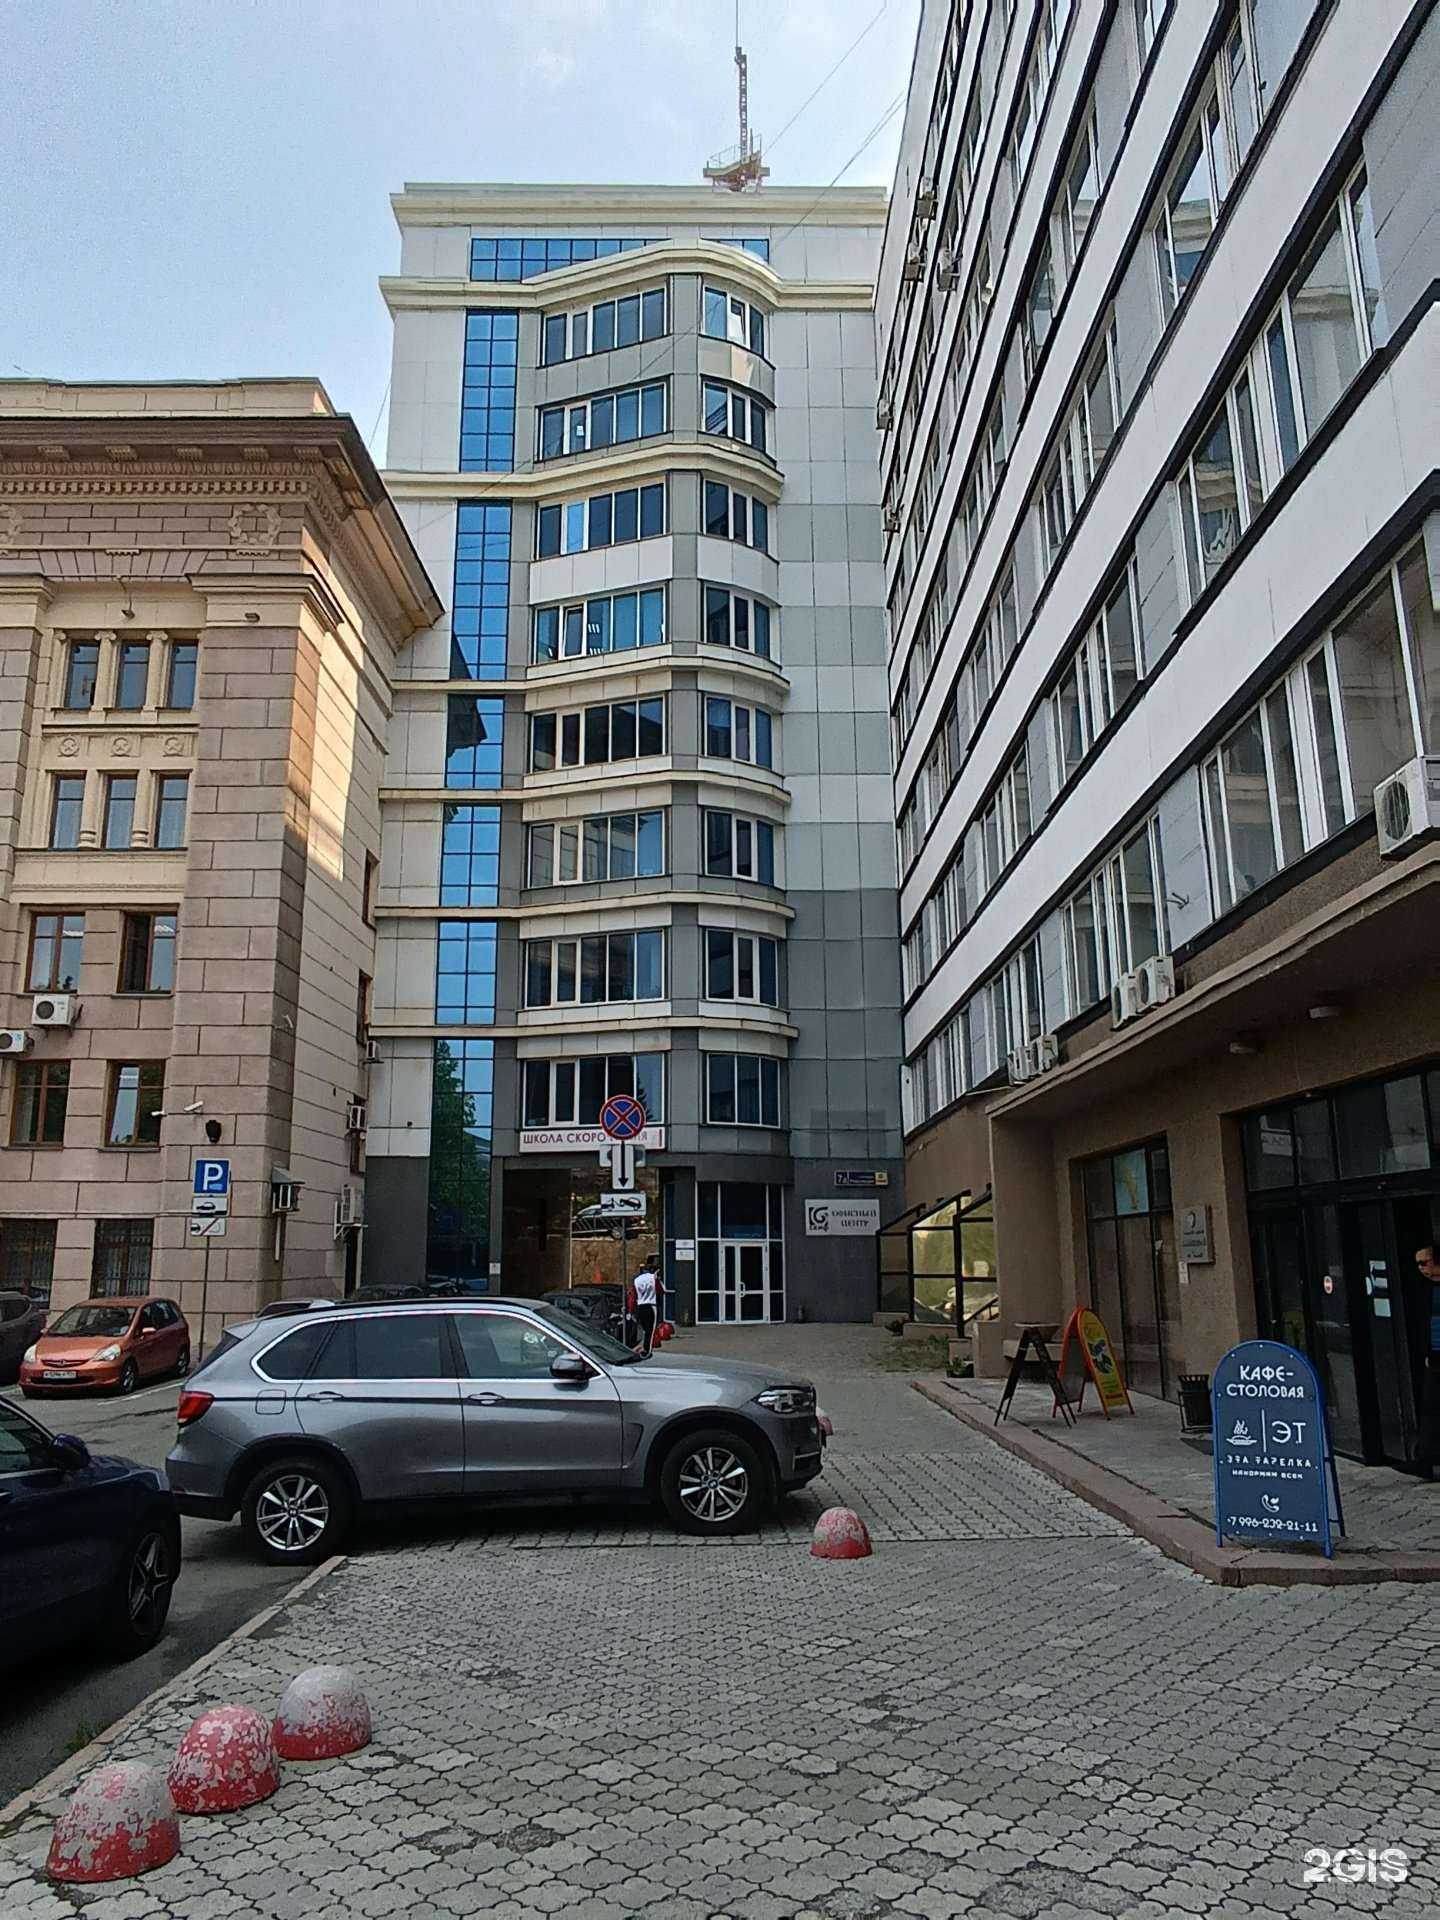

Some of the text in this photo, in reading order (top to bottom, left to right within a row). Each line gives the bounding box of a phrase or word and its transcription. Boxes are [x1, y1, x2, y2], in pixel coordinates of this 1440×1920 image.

[523, 1133, 563, 1144] ШКОЛА
[203, 1163, 223, 1191] P
[1239, 1365, 1294, 1382] КАФЕ-
[1226, 1383, 1304, 1398] СТОЛОВАЯ
[1271, 1420, 1306, 1444] ЭТ
[1227, 1454, 1312, 1468] ЭТА ТАРЕЛКА
